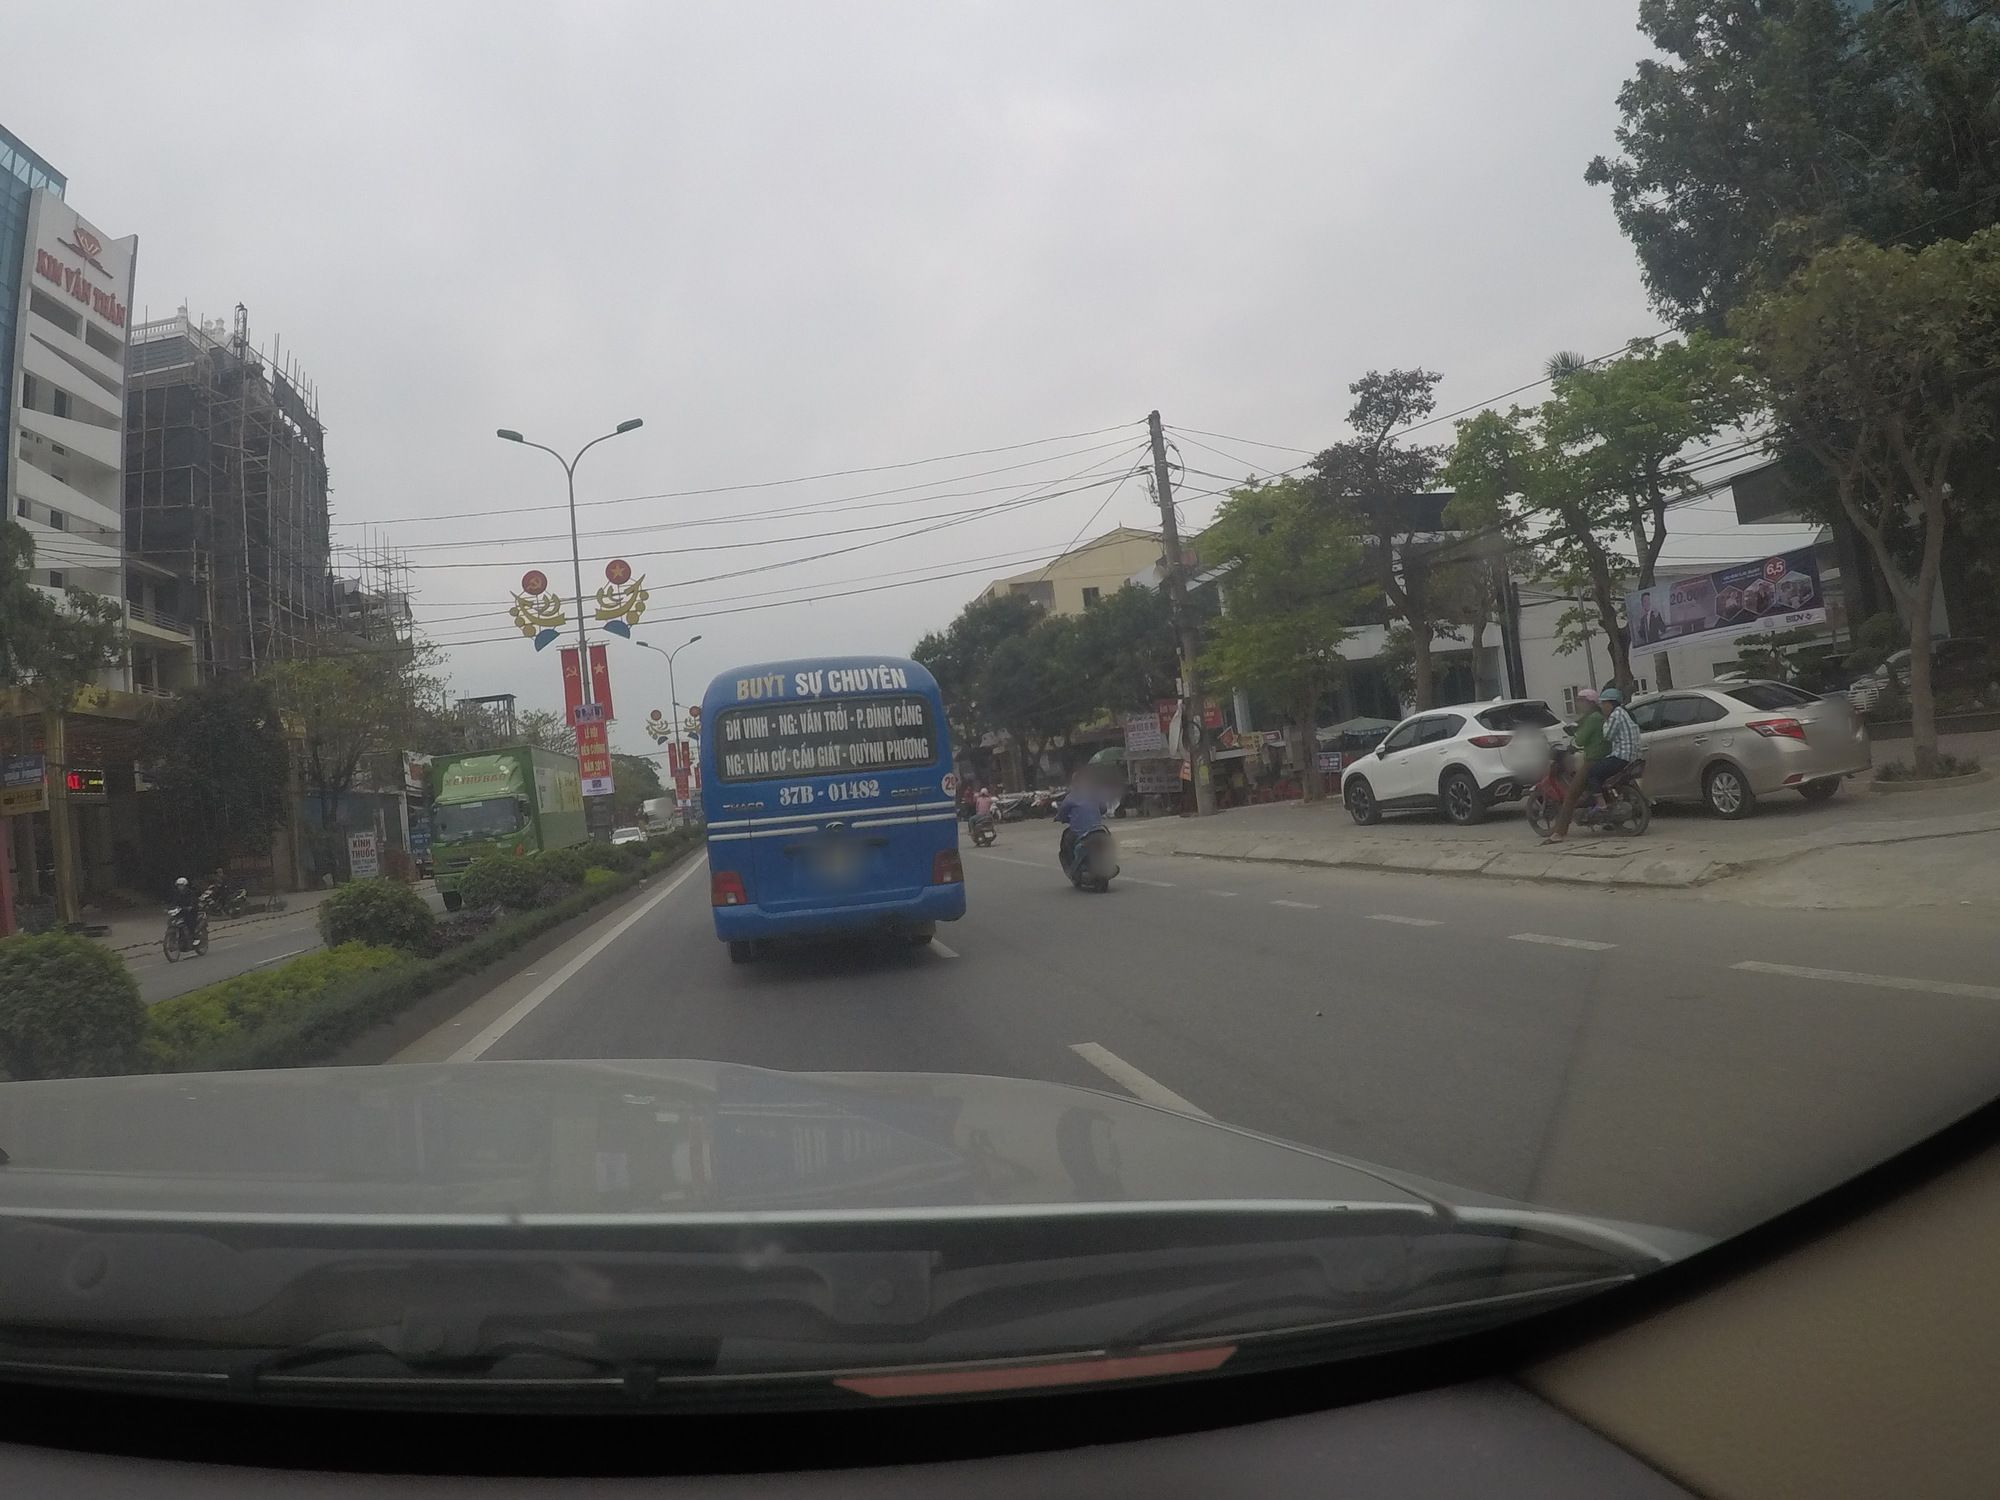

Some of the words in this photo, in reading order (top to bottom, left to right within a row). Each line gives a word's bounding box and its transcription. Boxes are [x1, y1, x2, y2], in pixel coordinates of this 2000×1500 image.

[736, 672, 784, 700] BUÝT
[795, 669, 823, 697] SỰ
[828, 665, 907, 692] CHUYÊN
[743, 716, 769, 739] VINH
[778, 714, 798, 736] NG:
[725, 754, 745, 776] NG:
[746, 748, 769, 774] VĂN
[817, 741, 840, 767] GIÁT
[849, 738, 885, 766] QUỲNH
[886, 737, 929, 761] PHƯƠNG
[779, 785, 814, 806] 37B
[828, 779, 880, 802] 01482
